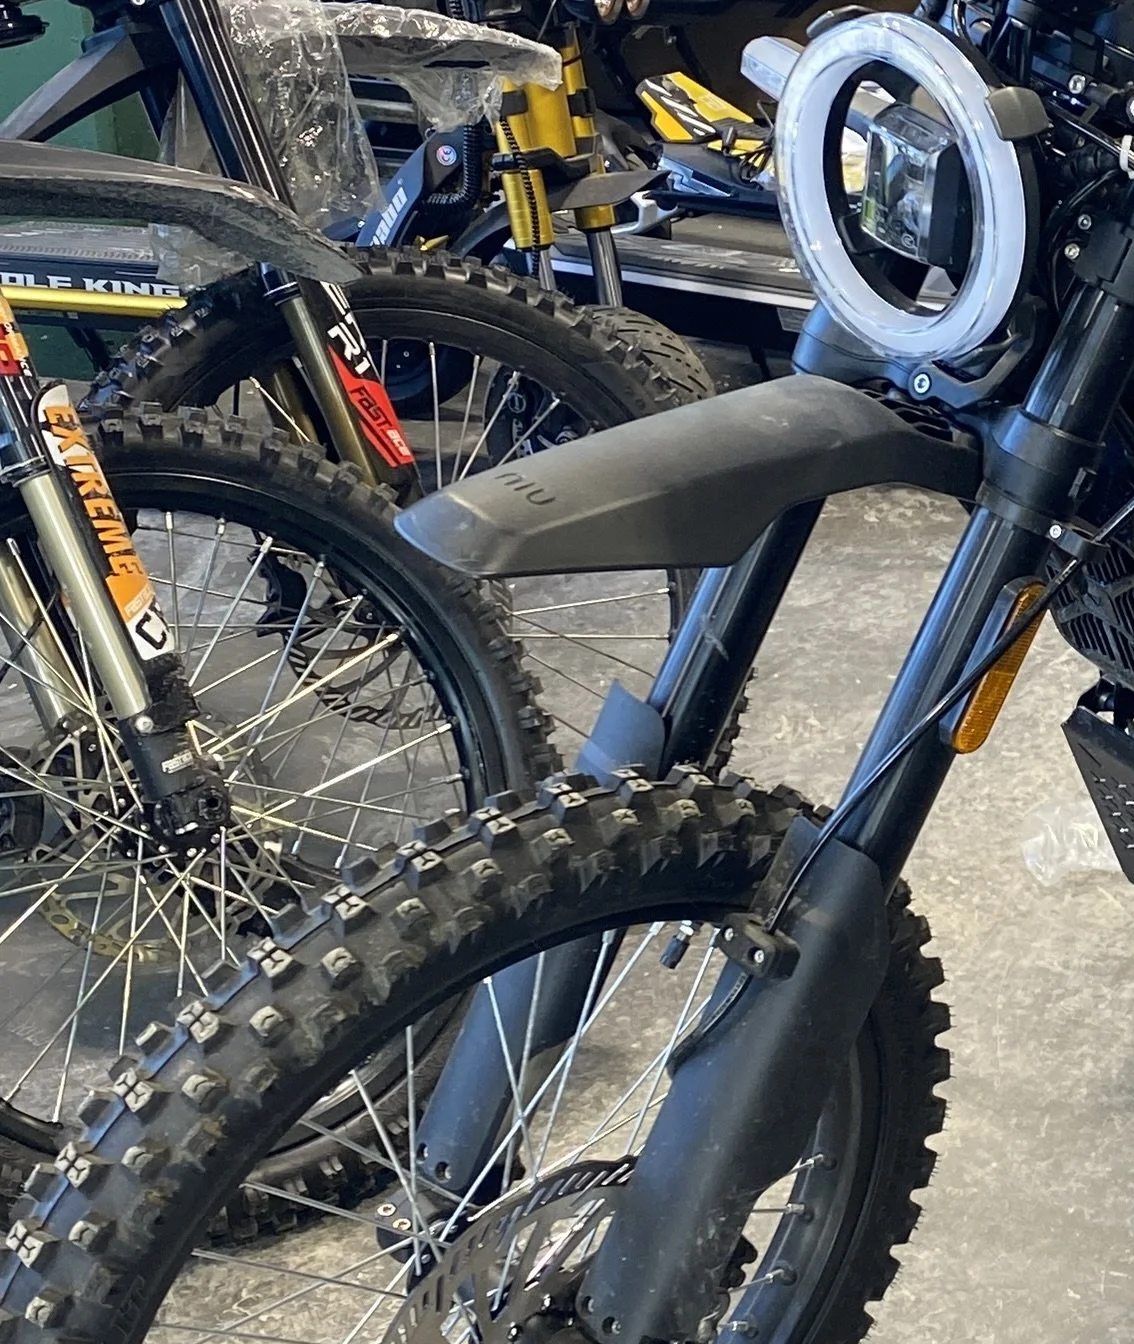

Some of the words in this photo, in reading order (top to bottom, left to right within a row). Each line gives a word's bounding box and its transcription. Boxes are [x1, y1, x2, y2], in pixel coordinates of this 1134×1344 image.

[0, 271, 72, 289] OLF
[82, 277, 180, 297] KING
[42, 405, 143, 578] EXTREME
[495, 472, 556, 506] niu
